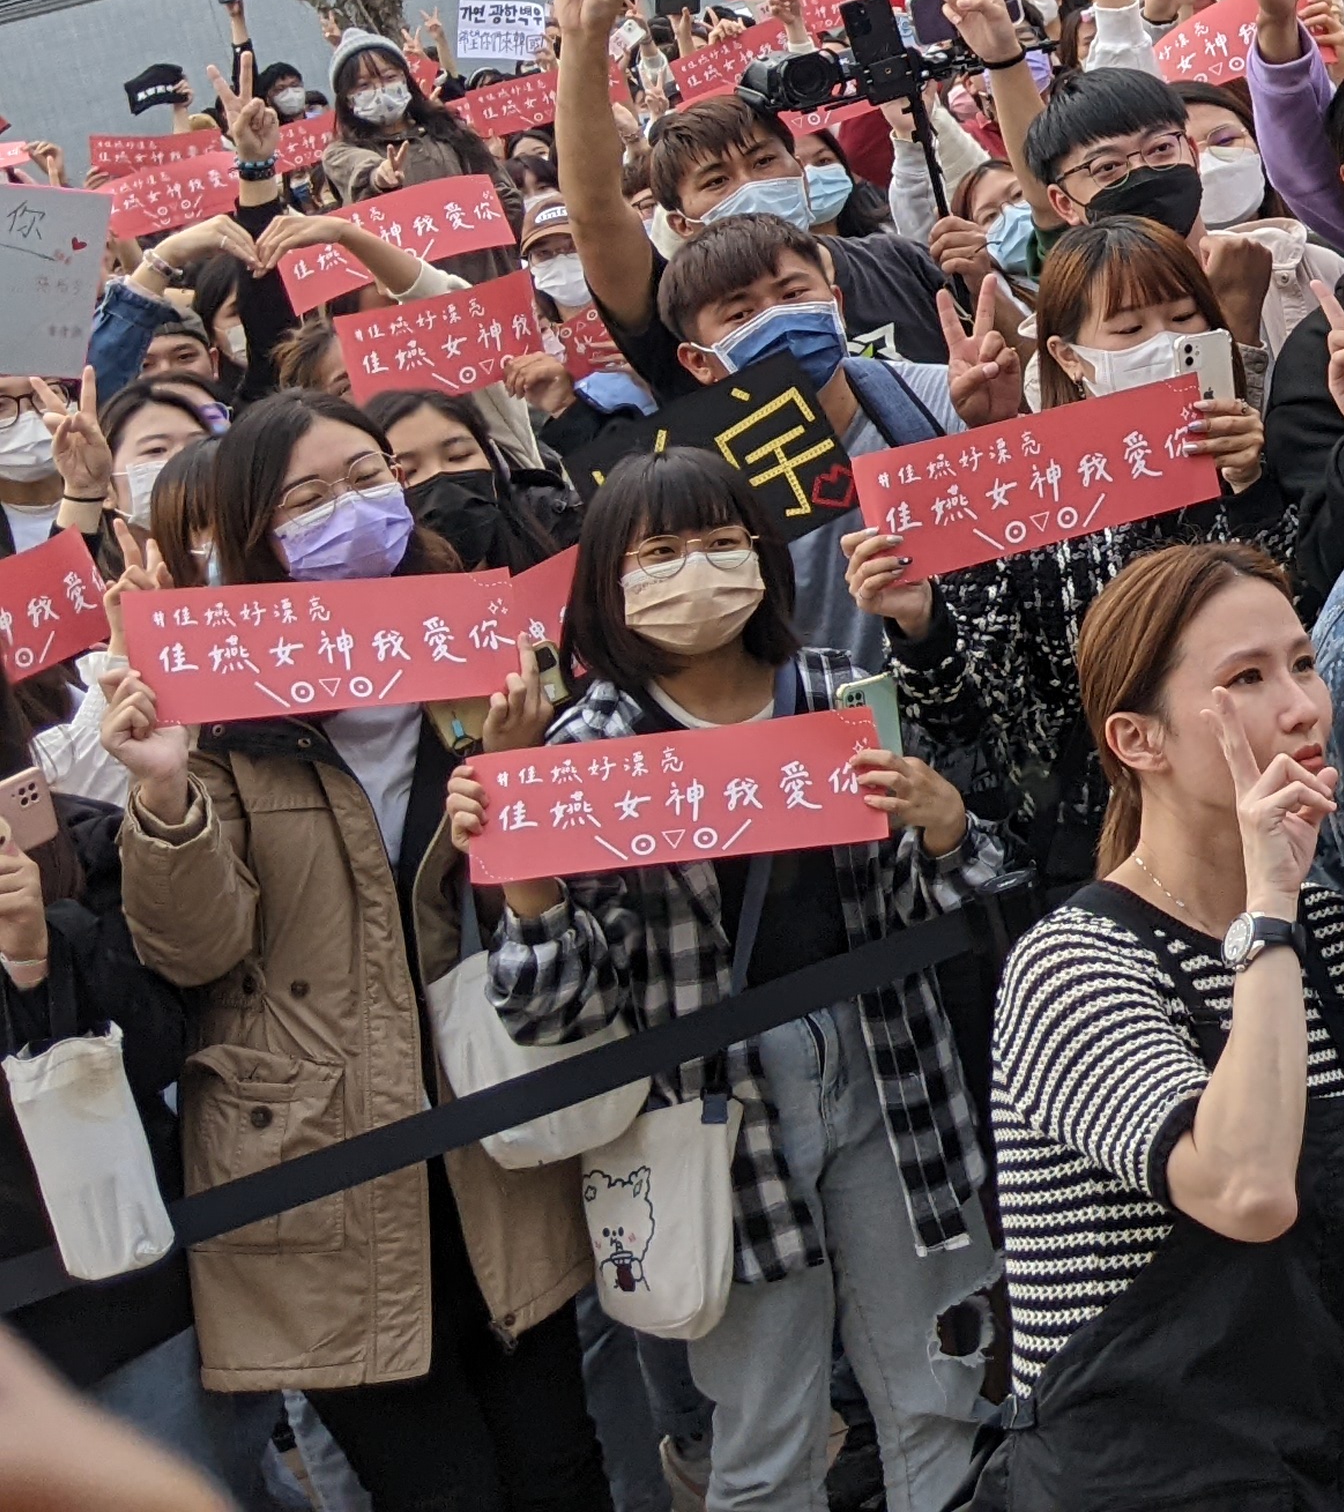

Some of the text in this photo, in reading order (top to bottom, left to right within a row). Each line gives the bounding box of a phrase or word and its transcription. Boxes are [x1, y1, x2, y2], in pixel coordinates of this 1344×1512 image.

[6, 200, 46, 240] 你
[354, 299, 485, 341] #佳嬿好漂亮
[877, 431, 1041, 488] #佳嬿好漂亮
[152, 596, 331, 628] #佳嬿好漂亮
[159, 615, 516, 674] 佳嬿女神我愛你
[497, 747, 684, 787] #佳嬿好漂亮
[499, 760, 860, 830] 佳嬿女神我愛你
